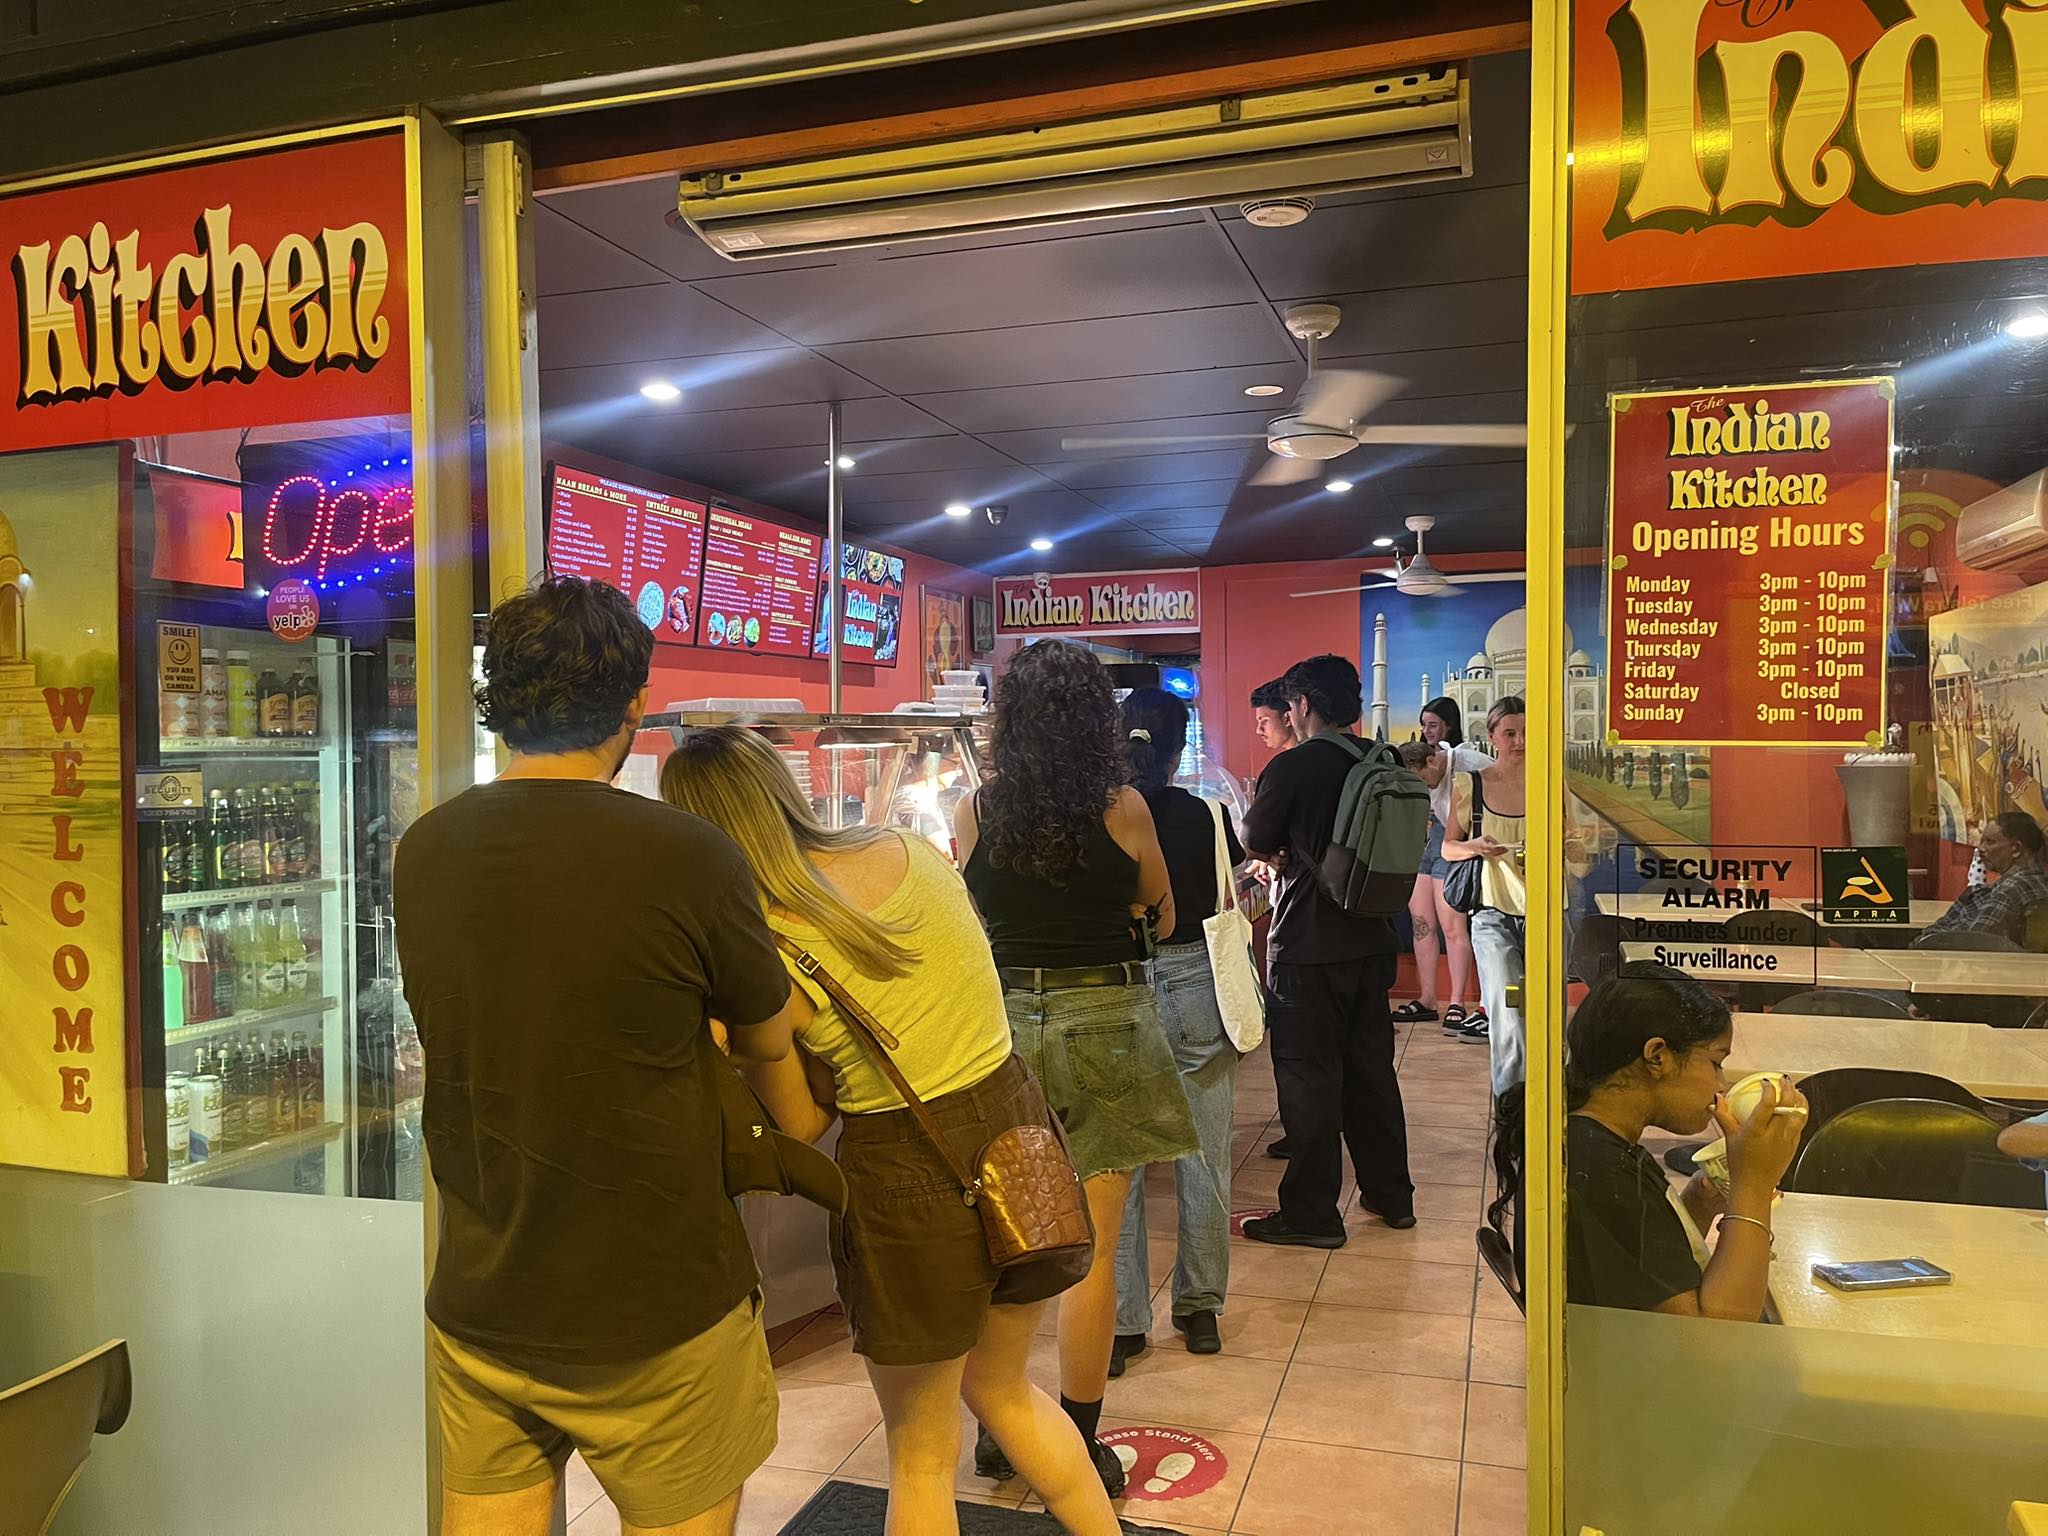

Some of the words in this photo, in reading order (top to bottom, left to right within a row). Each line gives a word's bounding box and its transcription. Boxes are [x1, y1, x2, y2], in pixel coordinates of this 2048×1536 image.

[14, 203, 390, 405] Kitchen
[1691, 396, 1726, 414] The
[1668, 399, 1831, 458] Indian
[556, 477, 577, 490] NAAN
[577, 482, 602, 496] BREADS
[603, 488, 609, 497] &
[609, 490, 627, 502] MORE
[1668, 466, 1828, 511] Kitchen
[670, 506, 683, 516] AND
[683, 509, 698, 520] BITES
[1632, 520, 1760, 557] Opening
[1769, 516, 1865, 549] Hours
[280, 586, 305, 594] PEOPLE
[1626, 575, 1691, 595] Monday
[1759, 573, 1799, 592] 3pm
[1817, 571, 1866, 591] 10pm
[275, 594, 297, 603] LOVE
[299, 594, 310, 603] US
[846, 592, 876, 622] Indian
[1002, 586, 1084, 627] Indian
[1089, 582, 1194, 625] Kitchen
[1625, 597, 1693, 617] Tuesday
[1759, 595, 1798, 614] 3pm
[1817, 593, 1866, 613] 10pm
[163, 626, 196, 638] SMILE!
[272, 612, 301, 631] yelp
[1625, 618, 1718, 638] Wednesday
[1758, 617, 1797, 636] 3pm
[1817, 615, 1865, 635] 10pm
[843, 623, 874, 648] Kitchen
[1625, 640, 1701, 659] Thursday
[1758, 638, 1797, 658] 3pm
[1816, 637, 1864, 657] 10pm
[1624, 661, 1676, 680] Friday
[1757, 660, 1796, 679] 3pm
[1815, 659, 1864, 679] 10pm
[1624, 682, 1700, 702] Saturday
[1781, 682, 1840, 700] Closed
[1623, 704, 1685, 723] Sunday
[1756, 704, 1796, 723] 3pm
[1814, 703, 1863, 723] 10pm
[1639, 858, 1792, 882] SECURITY
[42, 687, 95, 1114] WELCOME
[1661, 887, 1770, 910] ALARM
[1634, 917, 1728, 941] Premises
[1737, 924, 1799, 943] under
[1653, 945, 1778, 971] Surveillance
[1096, 1430, 1139, 1445] lease
[1144, 1429, 1192, 1444] Stand
[1191, 1441, 1216, 1462] Here
